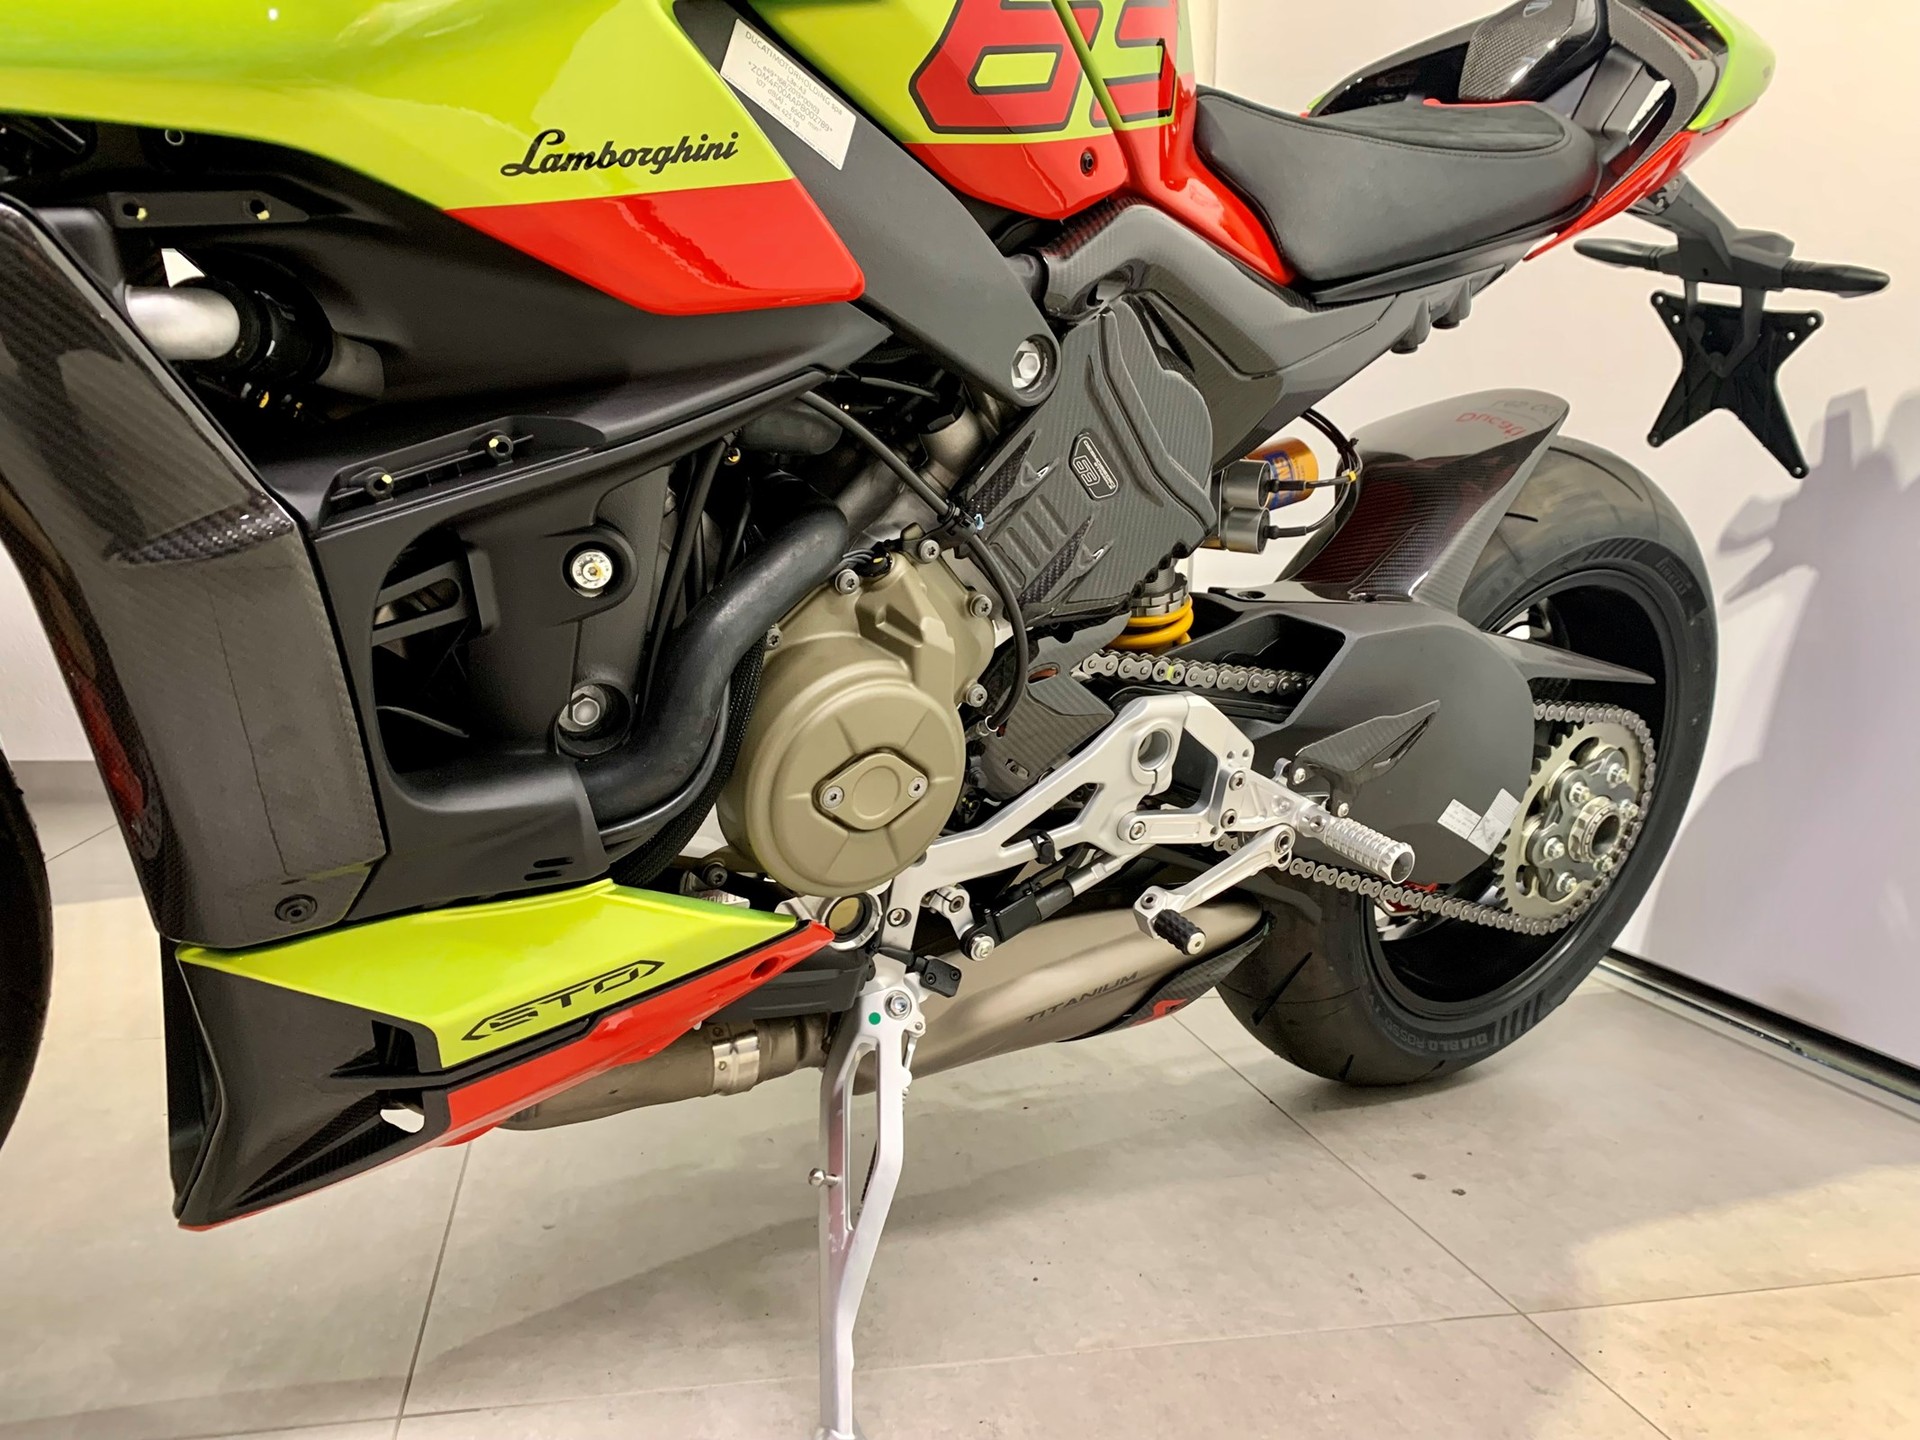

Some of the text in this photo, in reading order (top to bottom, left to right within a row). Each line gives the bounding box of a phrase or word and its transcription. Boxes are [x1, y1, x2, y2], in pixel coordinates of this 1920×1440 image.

[500, 129, 738, 176] Lamborghini
[1024, 971, 1139, 1023] TITANIUM
[1427, 1032, 1488, 1052] DIABLO
